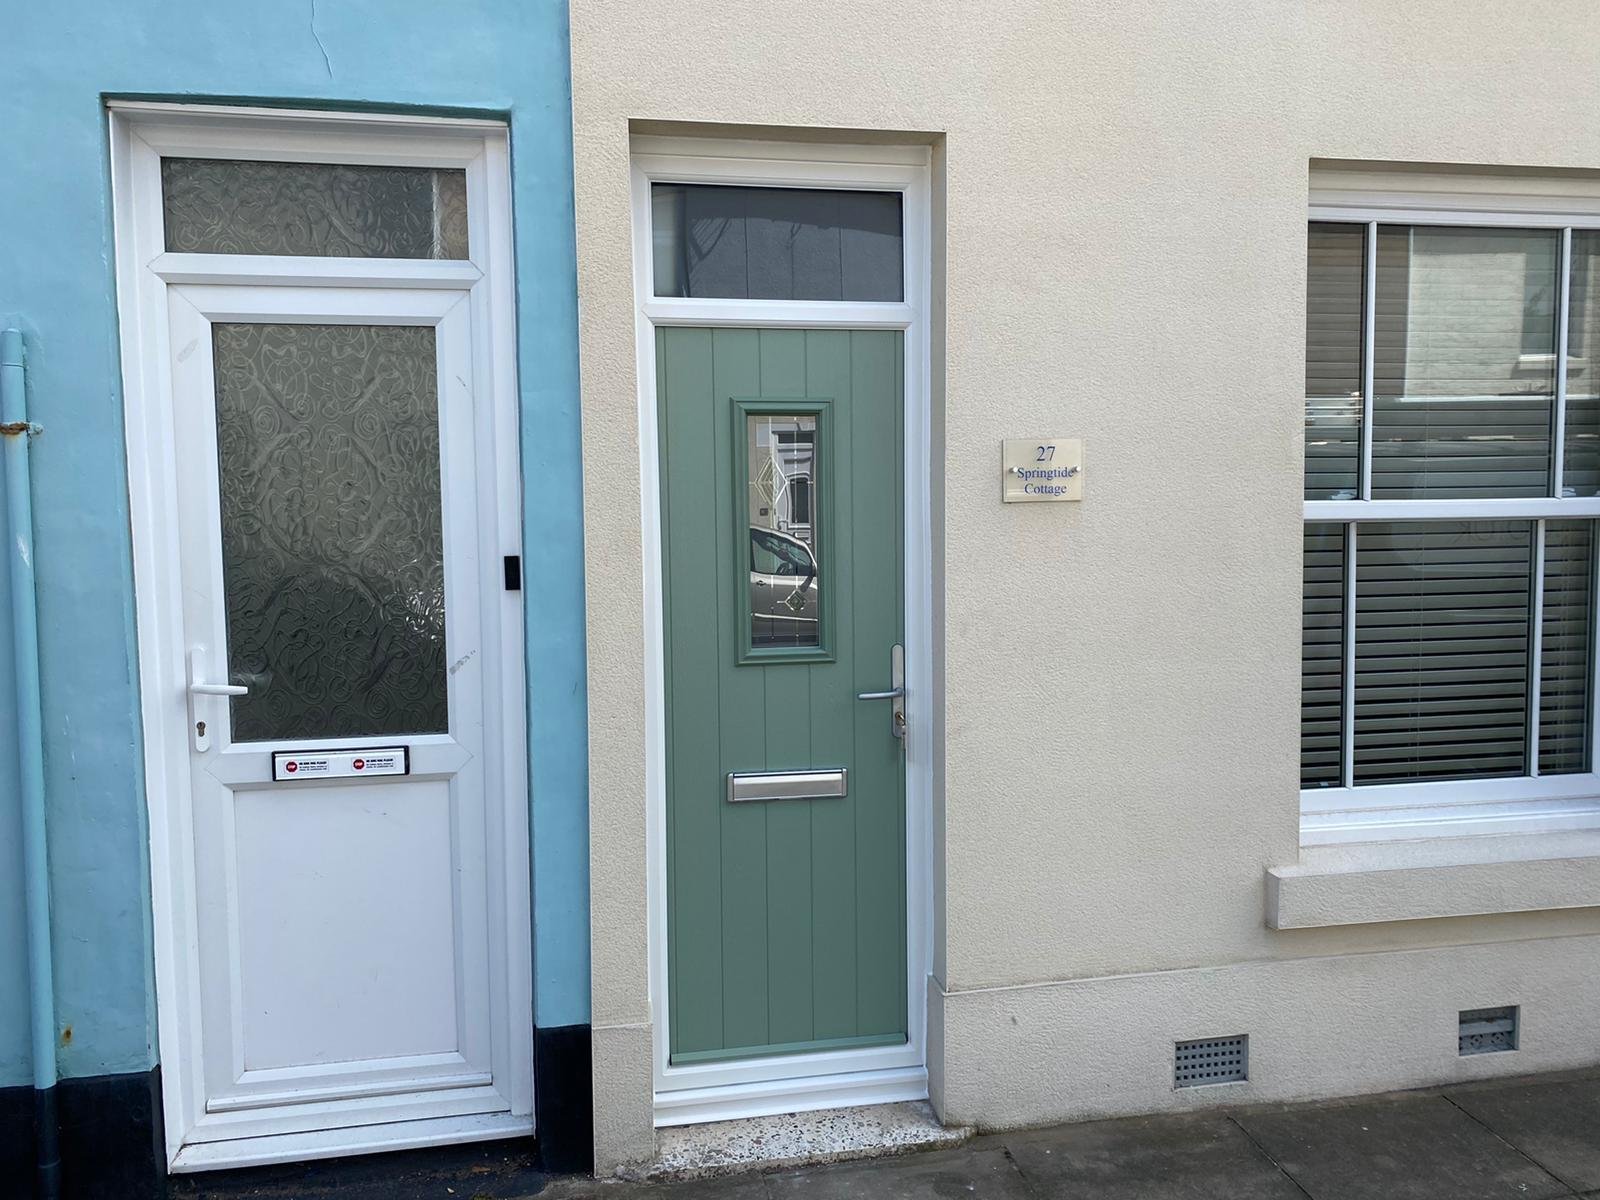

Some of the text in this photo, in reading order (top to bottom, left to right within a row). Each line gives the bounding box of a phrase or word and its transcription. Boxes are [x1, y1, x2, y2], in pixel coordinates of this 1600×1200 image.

[1036, 445, 1056, 462] 27
[1017, 466, 1074, 481] Springtide
[1024, 483, 1067, 497] Cottage
